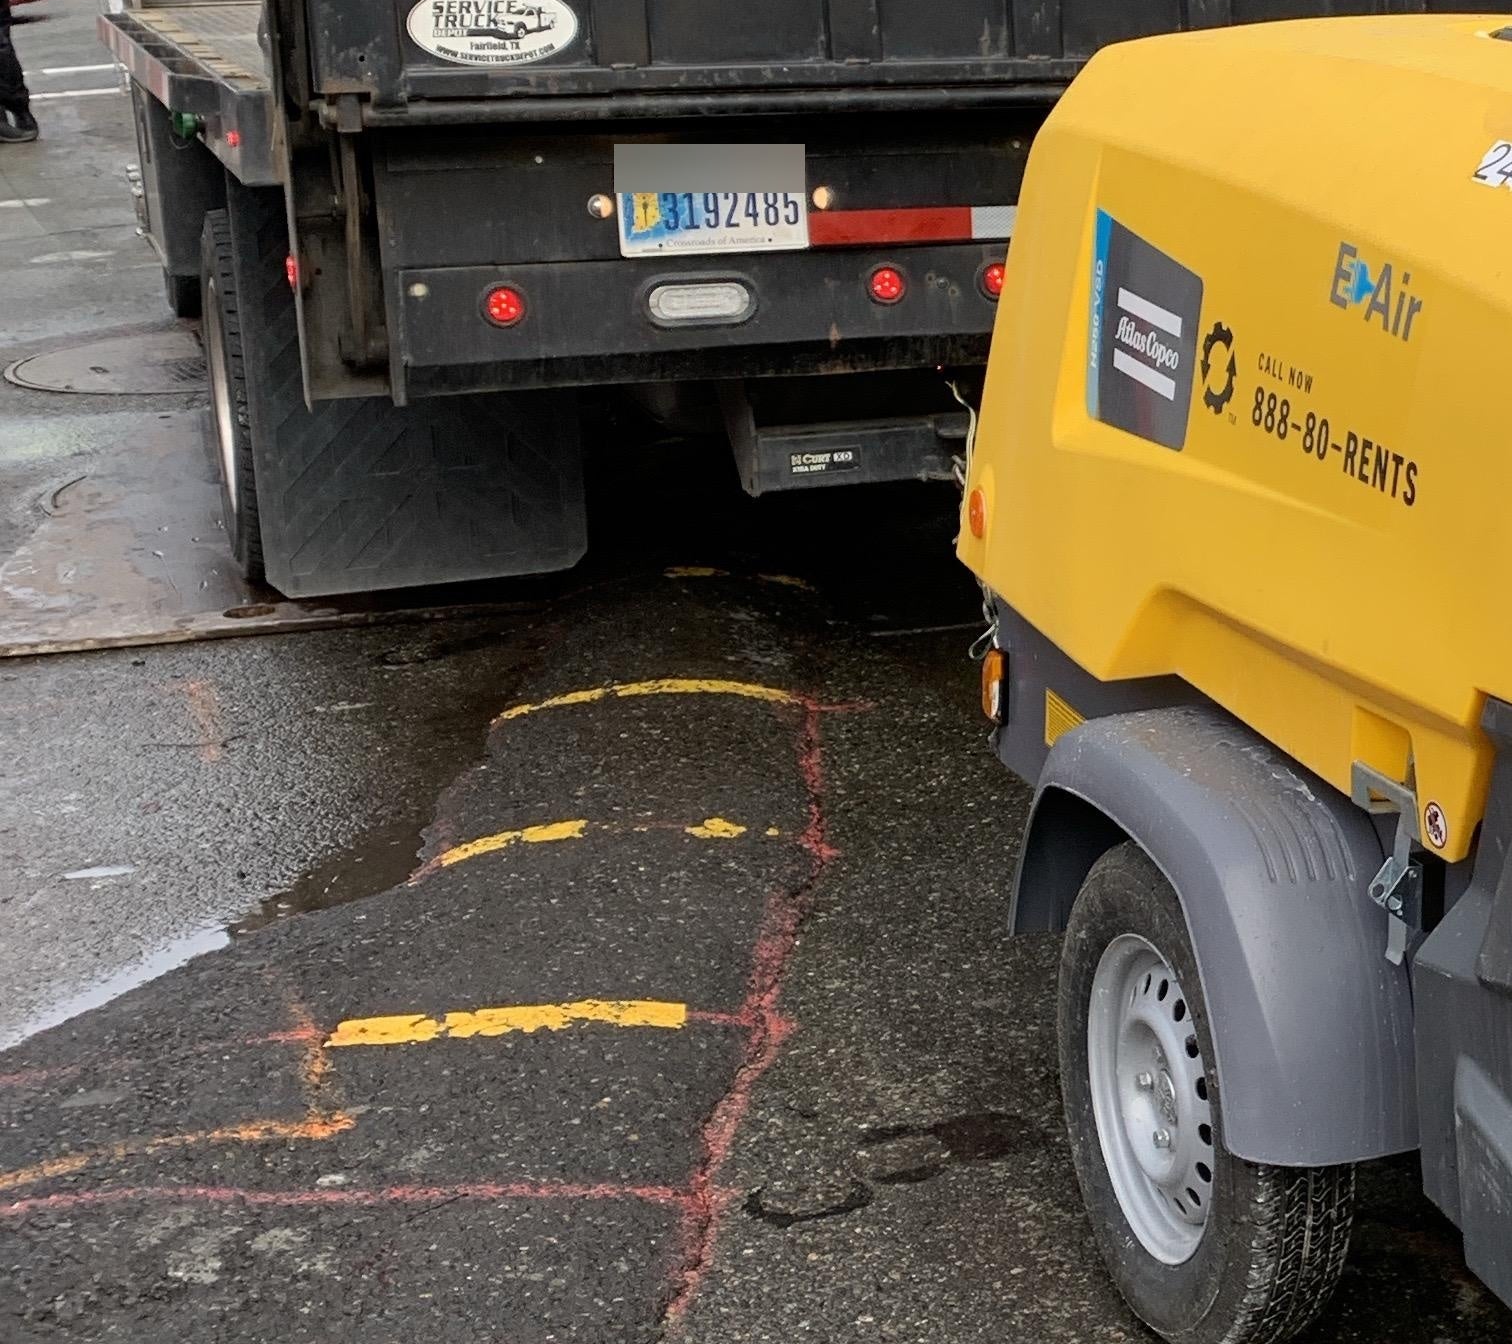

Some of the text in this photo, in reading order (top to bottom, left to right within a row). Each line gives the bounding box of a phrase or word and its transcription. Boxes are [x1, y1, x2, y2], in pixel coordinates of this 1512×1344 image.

[432, 0, 518, 14] SERVICE
[433, 14, 498, 28] TRUCK
[666, 235, 766, 248] Crossroads of America
[1115, 315, 1180, 370] Atlas Copco
[1258, 352, 1314, 394] CALL NOW
[1252, 386, 1418, 507] 888-80-RENTS
